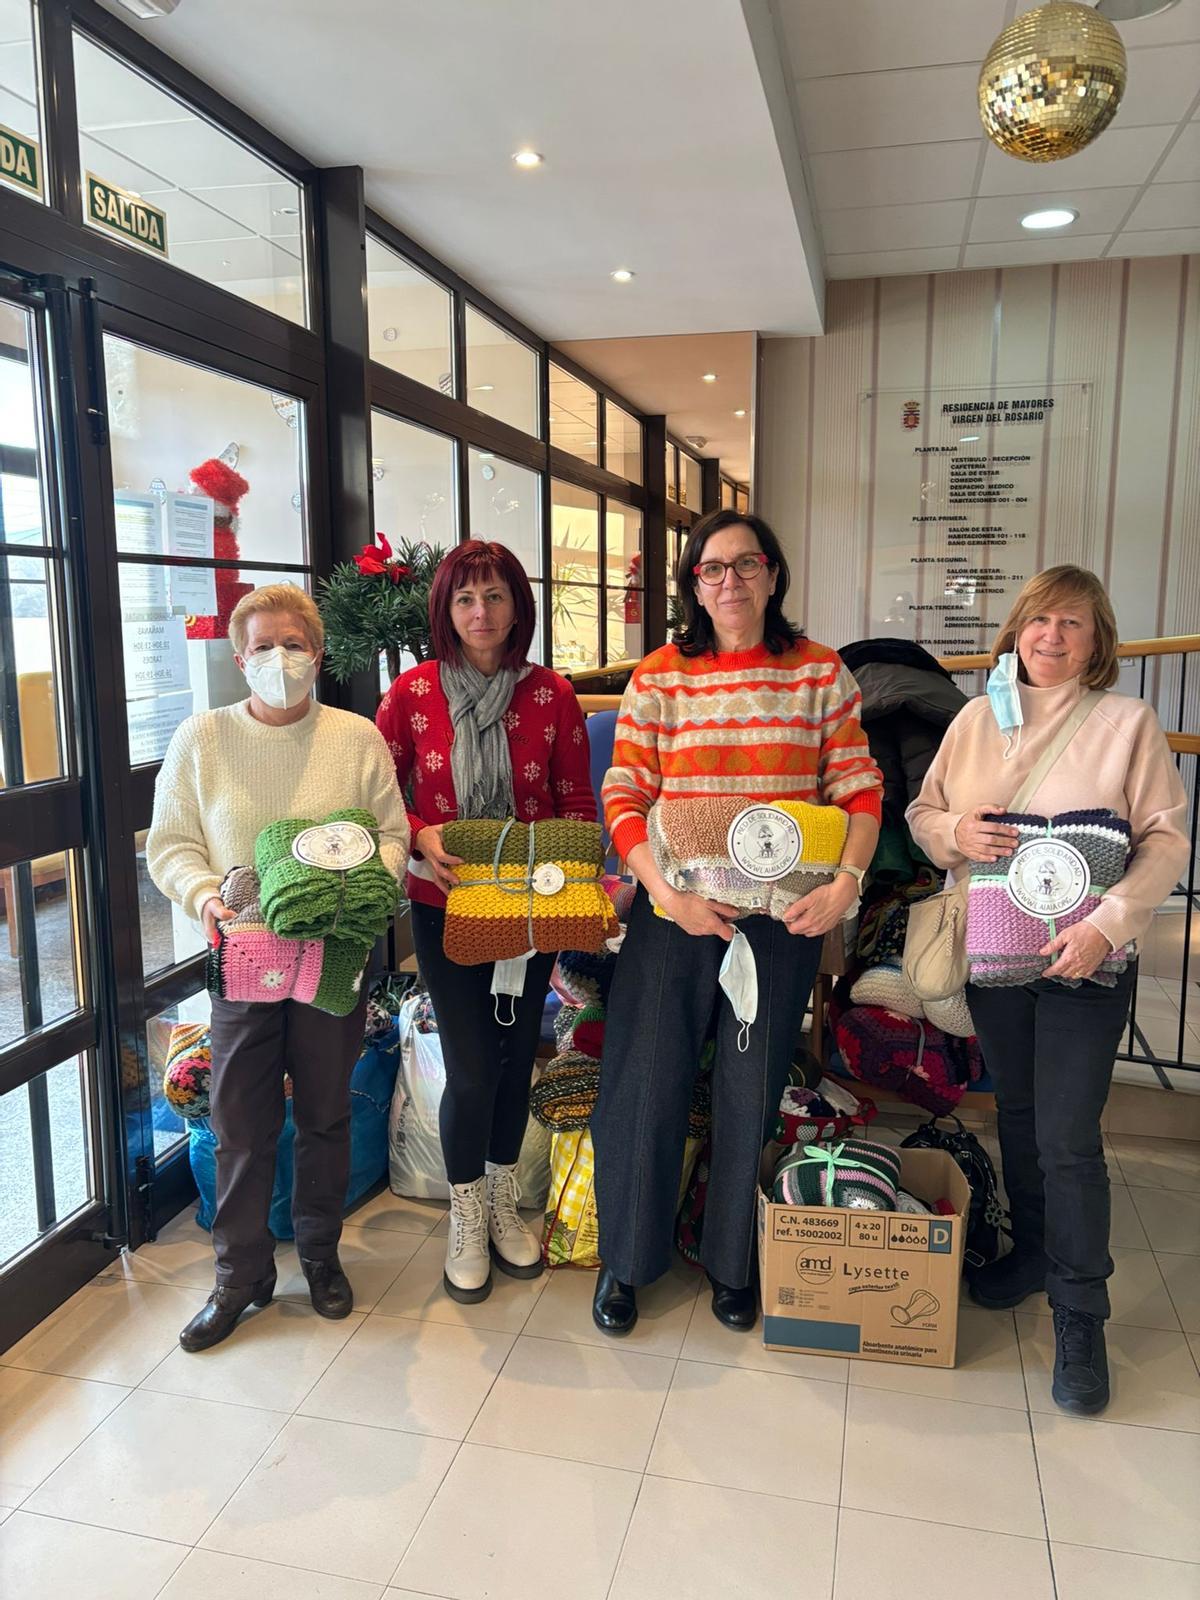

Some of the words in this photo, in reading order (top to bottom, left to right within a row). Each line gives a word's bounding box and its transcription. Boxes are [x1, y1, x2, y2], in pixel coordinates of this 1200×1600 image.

[94, 186, 161, 246] SALIDA
[942, 402, 995, 412] RESIDENCIA
[998, 400, 1009, 410] DE
[1012, 398, 1054, 409] MAYORES
[952, 414, 983, 424] VIRGEN
[986, 413, 1002, 422] DEL
[1004, 412, 1044, 422] ROSARIO
[780, 1215, 800, 1225] C.N.
[803, 1217, 839, 1227] 483669
[795, 1230, 842, 1240] 15002002
[933, 1228, 949, 1244] D
[800, 1256, 832, 1270] amd
[843, 1263, 909, 1280] Lysette
